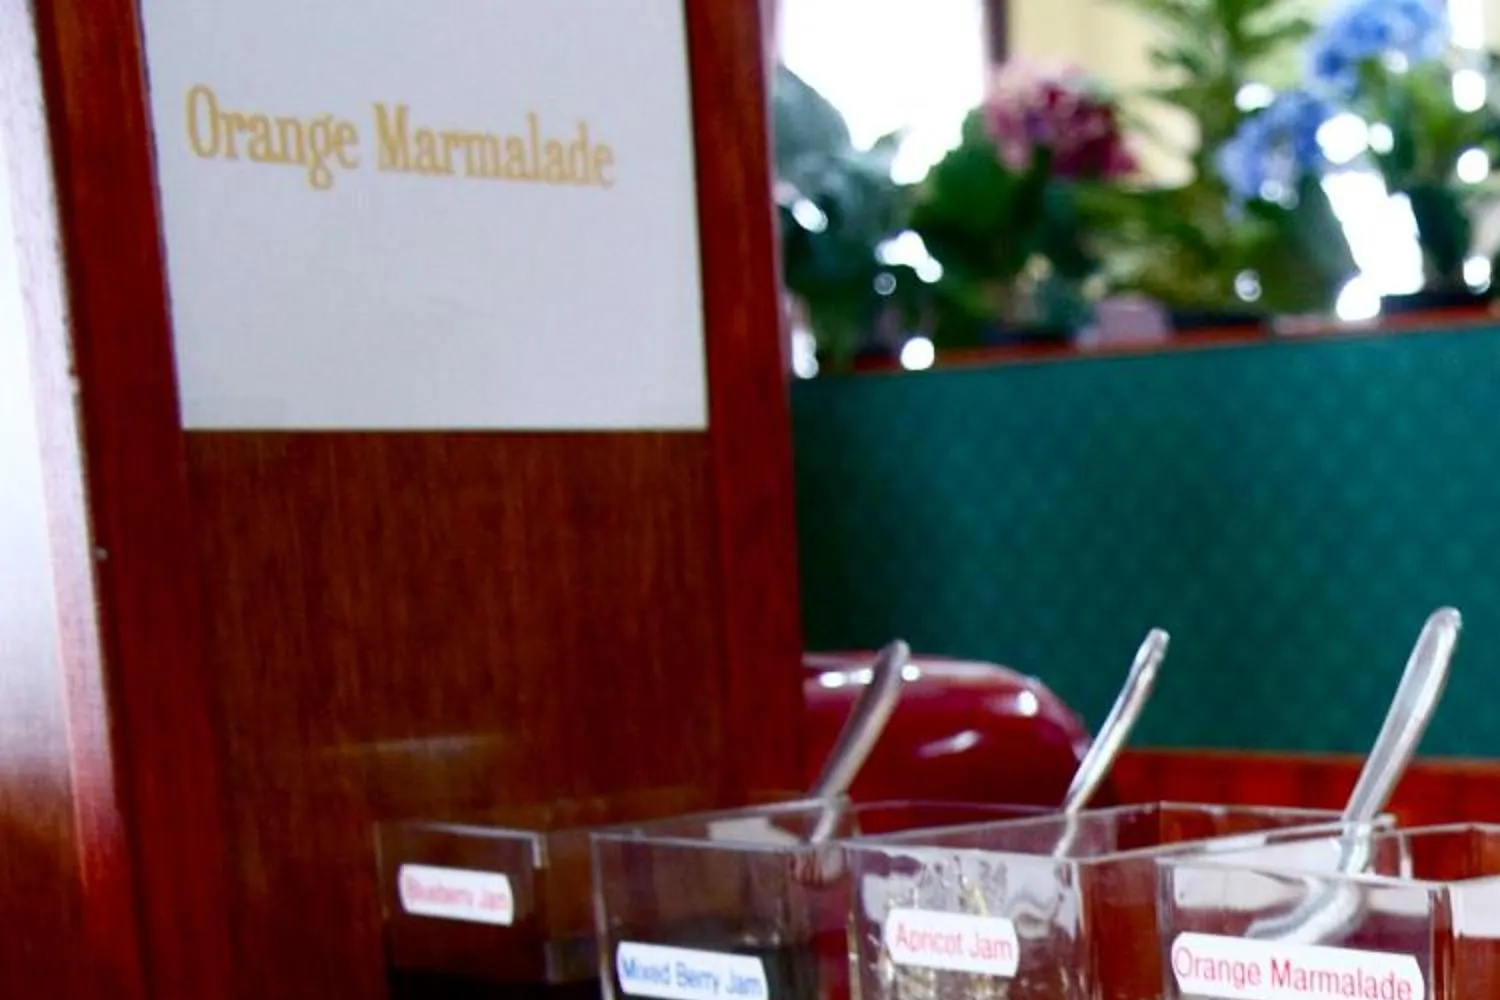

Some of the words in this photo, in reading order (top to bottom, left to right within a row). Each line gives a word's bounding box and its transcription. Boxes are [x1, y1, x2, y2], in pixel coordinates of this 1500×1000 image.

[185, 83, 359, 191] Orange
[373, 102, 615, 189] Marmalade
[895, 920, 964, 957] Apricot
[969, 929, 1013, 961] Jam
[622, 957, 671, 985] Mixed
[674, 960, 720, 995] Berry
[725, 968, 762, 996] Jam
[1174, 946, 1262, 989] Orange
